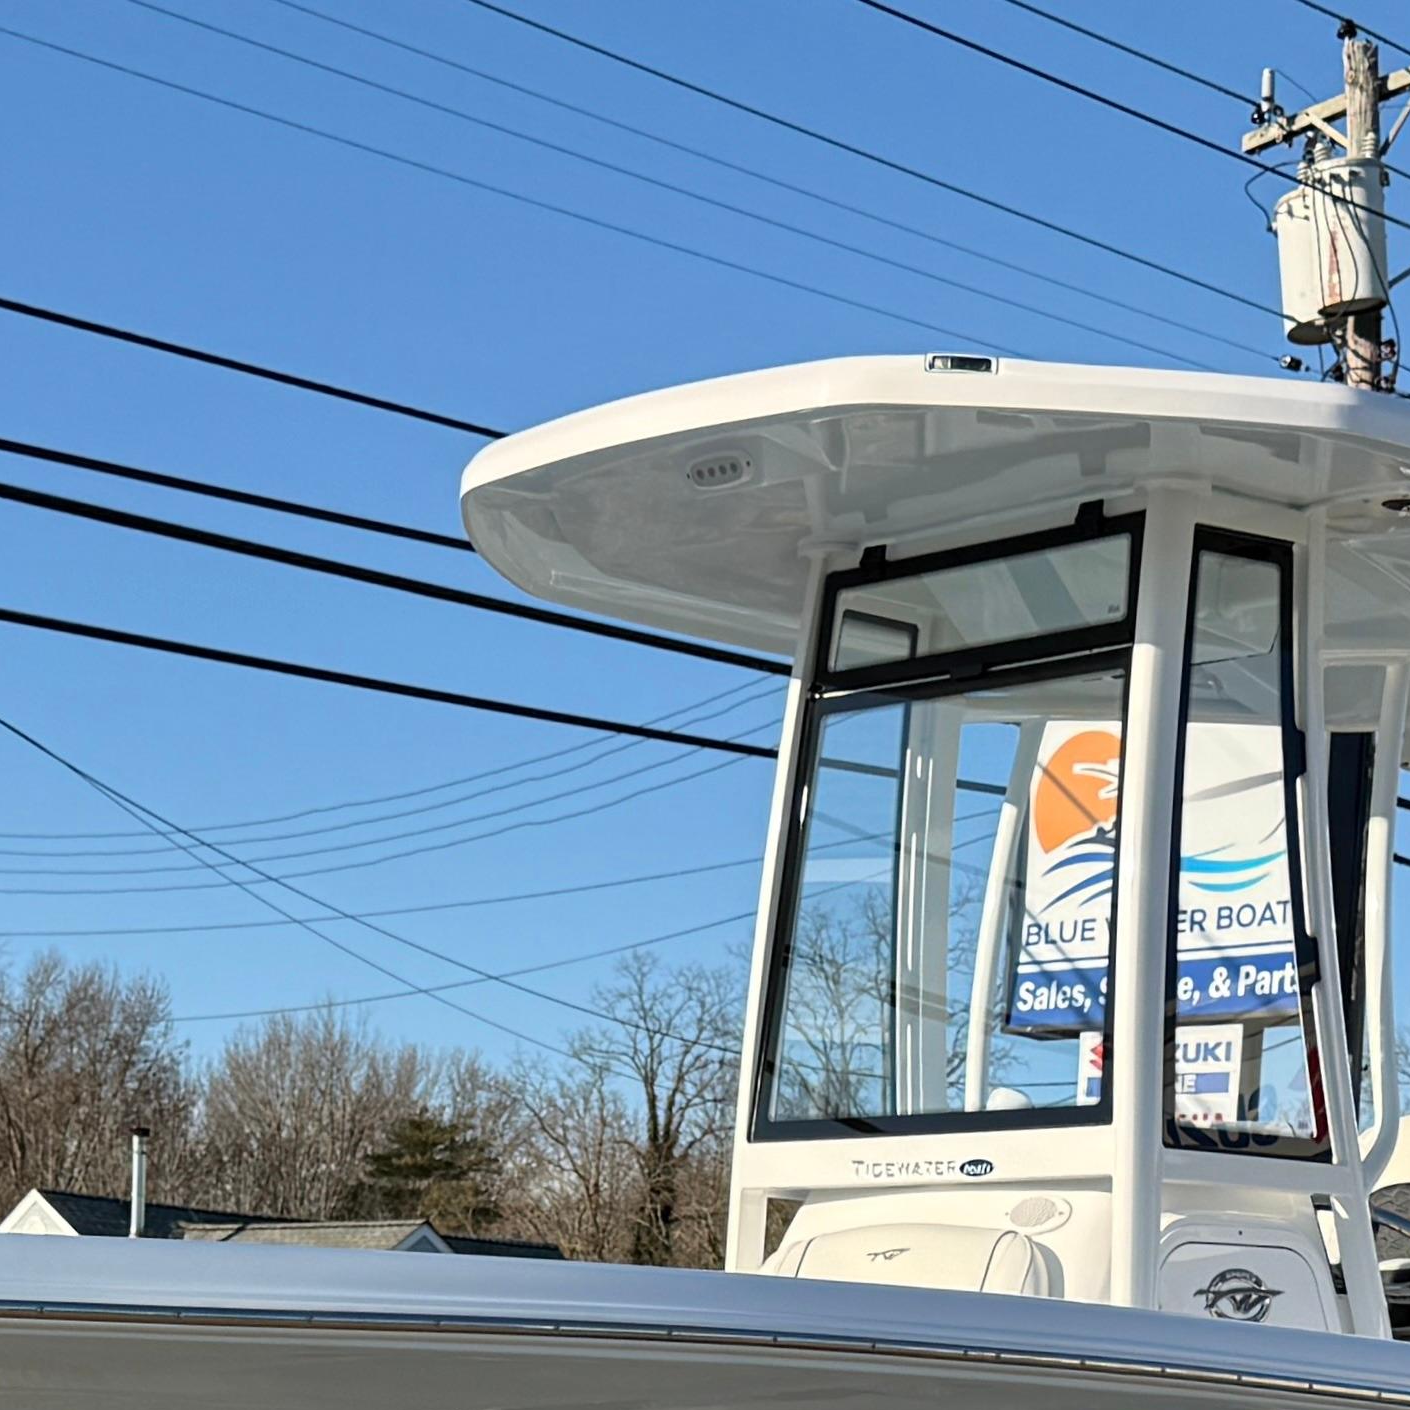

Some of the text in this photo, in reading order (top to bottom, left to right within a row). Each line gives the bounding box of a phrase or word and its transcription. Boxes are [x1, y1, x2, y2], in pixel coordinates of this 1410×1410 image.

[1025, 918, 1097, 946] BLUE
[1216, 900, 1291, 930] BOAT
[1016, 979, 1092, 1013] Sales,
[1208, 965, 1231, 998] &
[1176, 1040, 1232, 1063] UKI
